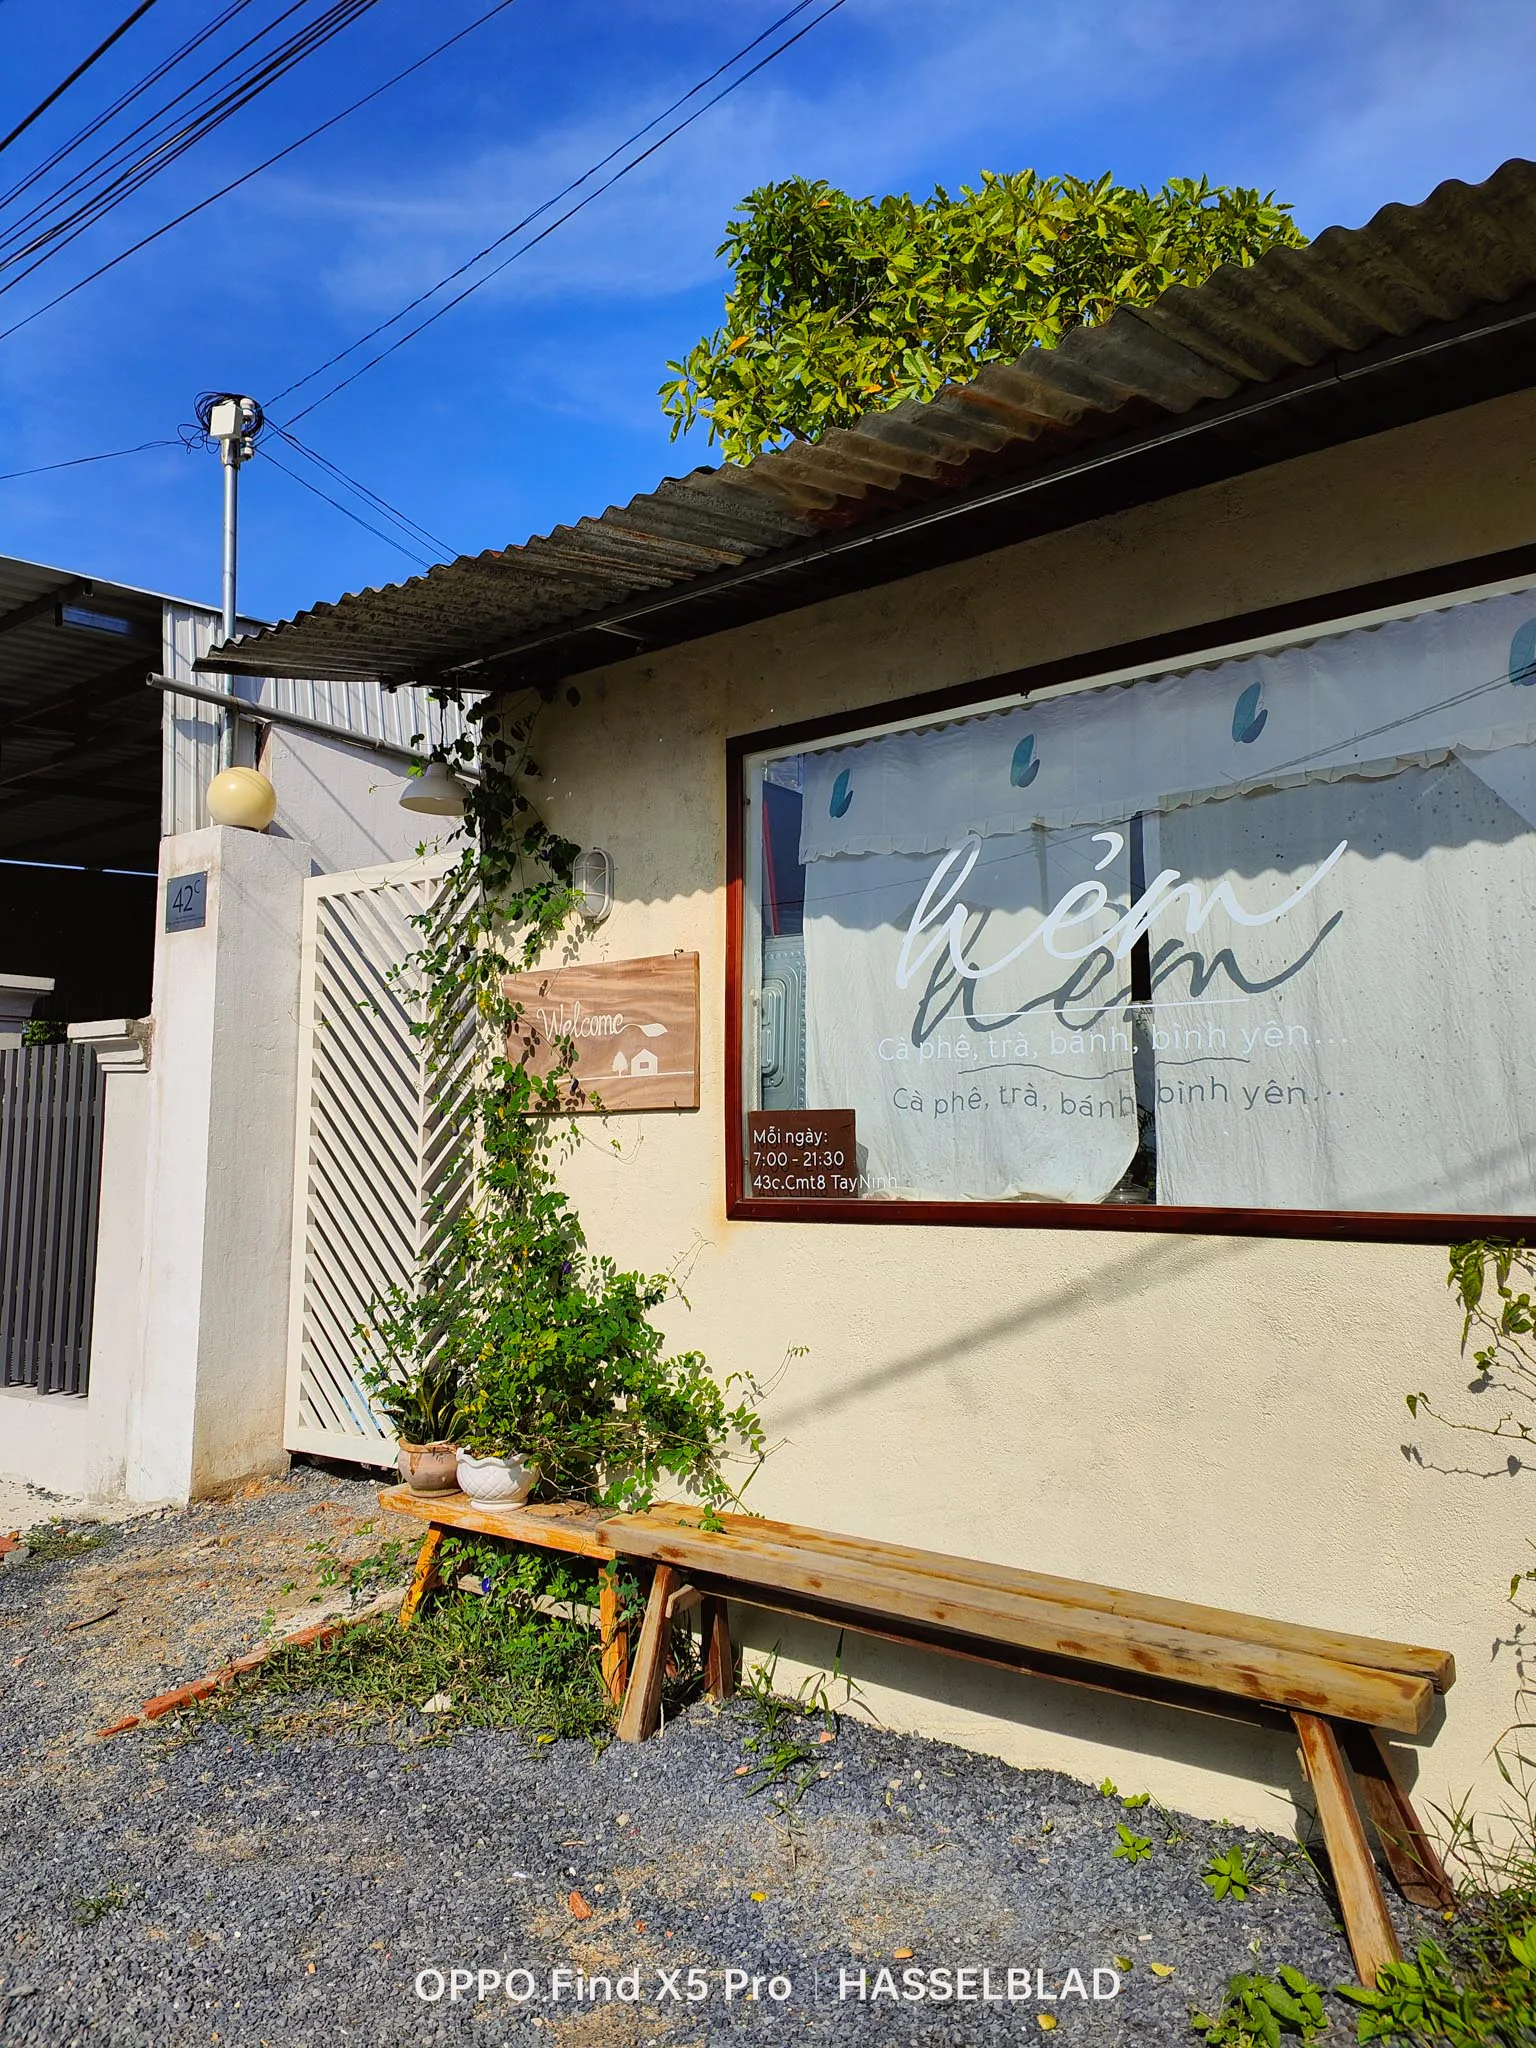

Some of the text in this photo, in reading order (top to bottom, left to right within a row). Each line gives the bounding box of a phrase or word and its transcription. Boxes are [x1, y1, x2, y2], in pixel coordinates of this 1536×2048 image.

[896, 832, 1348, 989] hẻm
[536, 1001, 624, 1041] Welcome
[878, 1035, 908, 1061] Cà
[919, 1035, 978, 1063] phê,
[987, 1032, 1038, 1060] trà,
[753, 1126, 828, 1146] Mỗi ngày:
[753, 1152, 788, 1167] 7:00
[803, 1151, 844, 1167] 21:30
[753, 1175, 826, 1190] 43c.Cmt8
